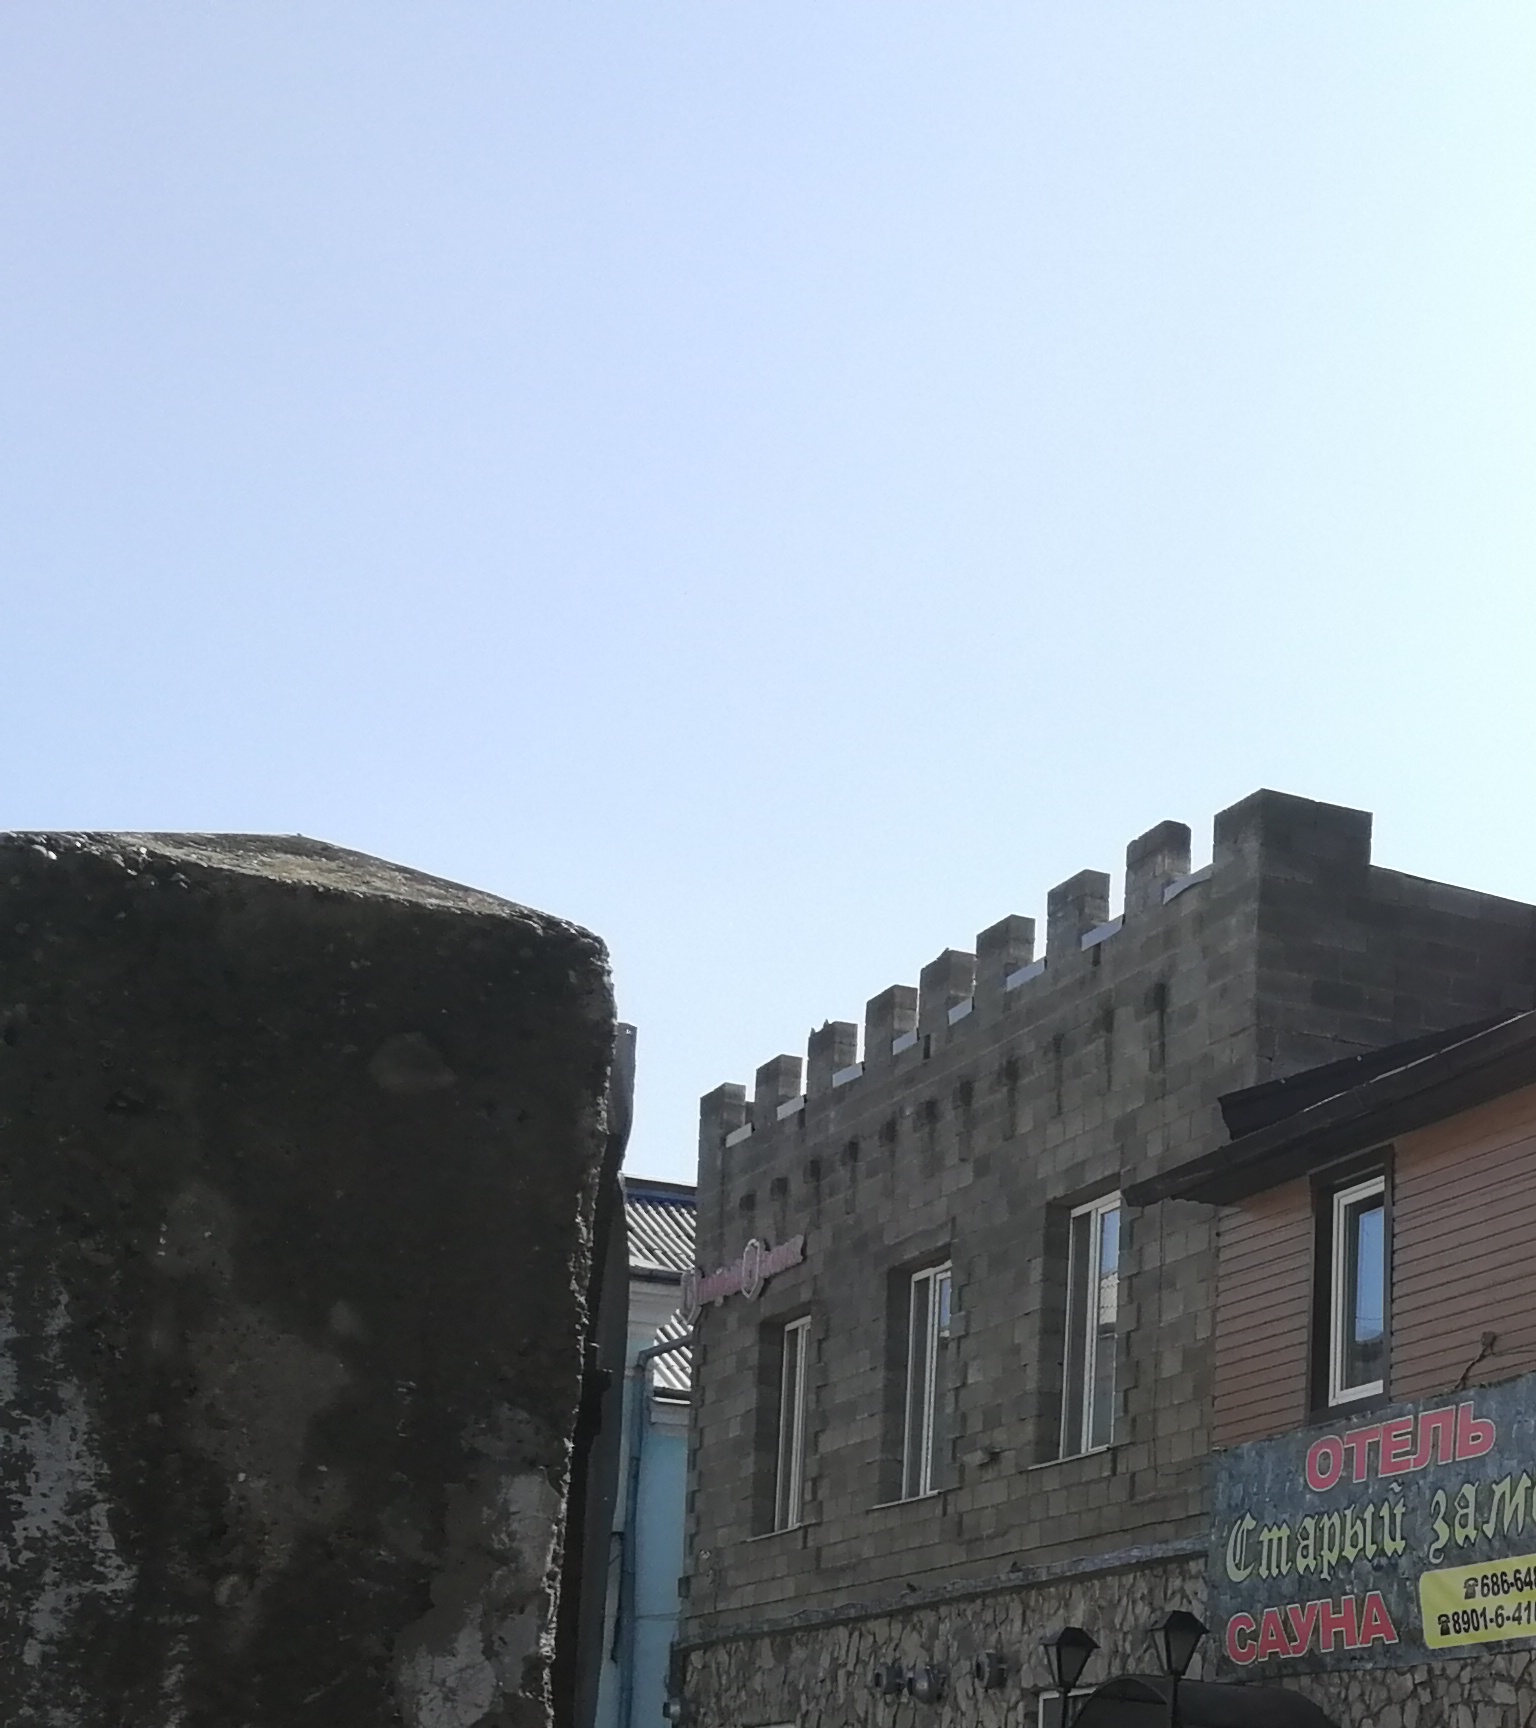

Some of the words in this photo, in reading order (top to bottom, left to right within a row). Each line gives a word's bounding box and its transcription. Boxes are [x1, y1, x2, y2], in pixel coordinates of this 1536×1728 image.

[1305, 1401, 1496, 1492] ОТЕЛЬ
[1226, 1482, 1408, 1583] Старый
[1226, 1590, 1398, 1665] САУНА
